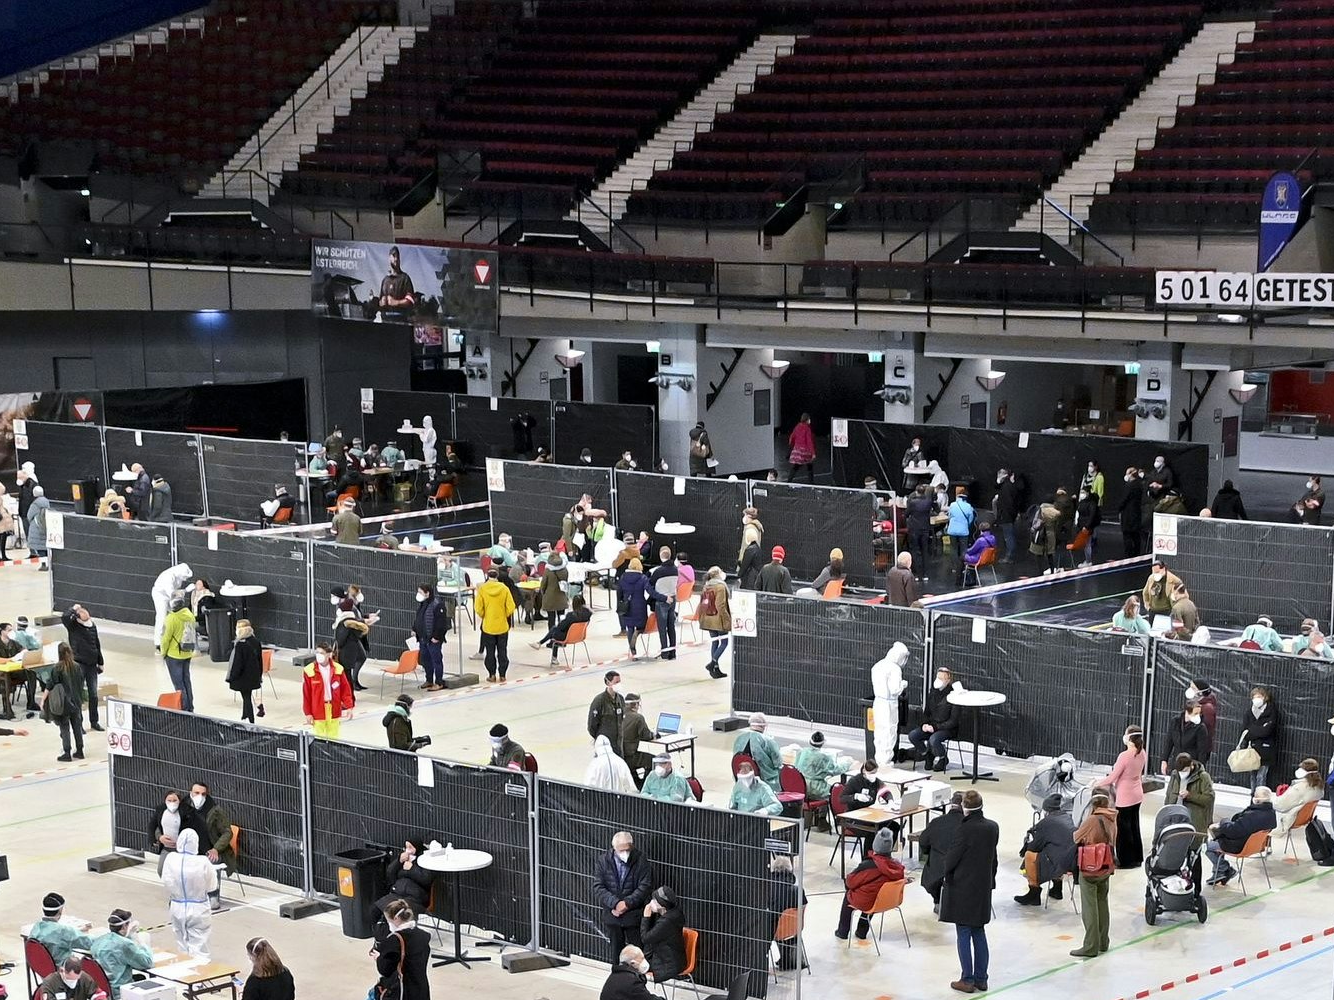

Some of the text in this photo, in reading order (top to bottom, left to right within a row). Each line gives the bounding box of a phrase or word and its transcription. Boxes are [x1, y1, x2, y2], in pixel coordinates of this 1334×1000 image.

[472, 345, 483, 357] A
[661, 355, 672, 366] B
[893, 366, 905, 378] C
[1147, 378, 1161, 391] D
